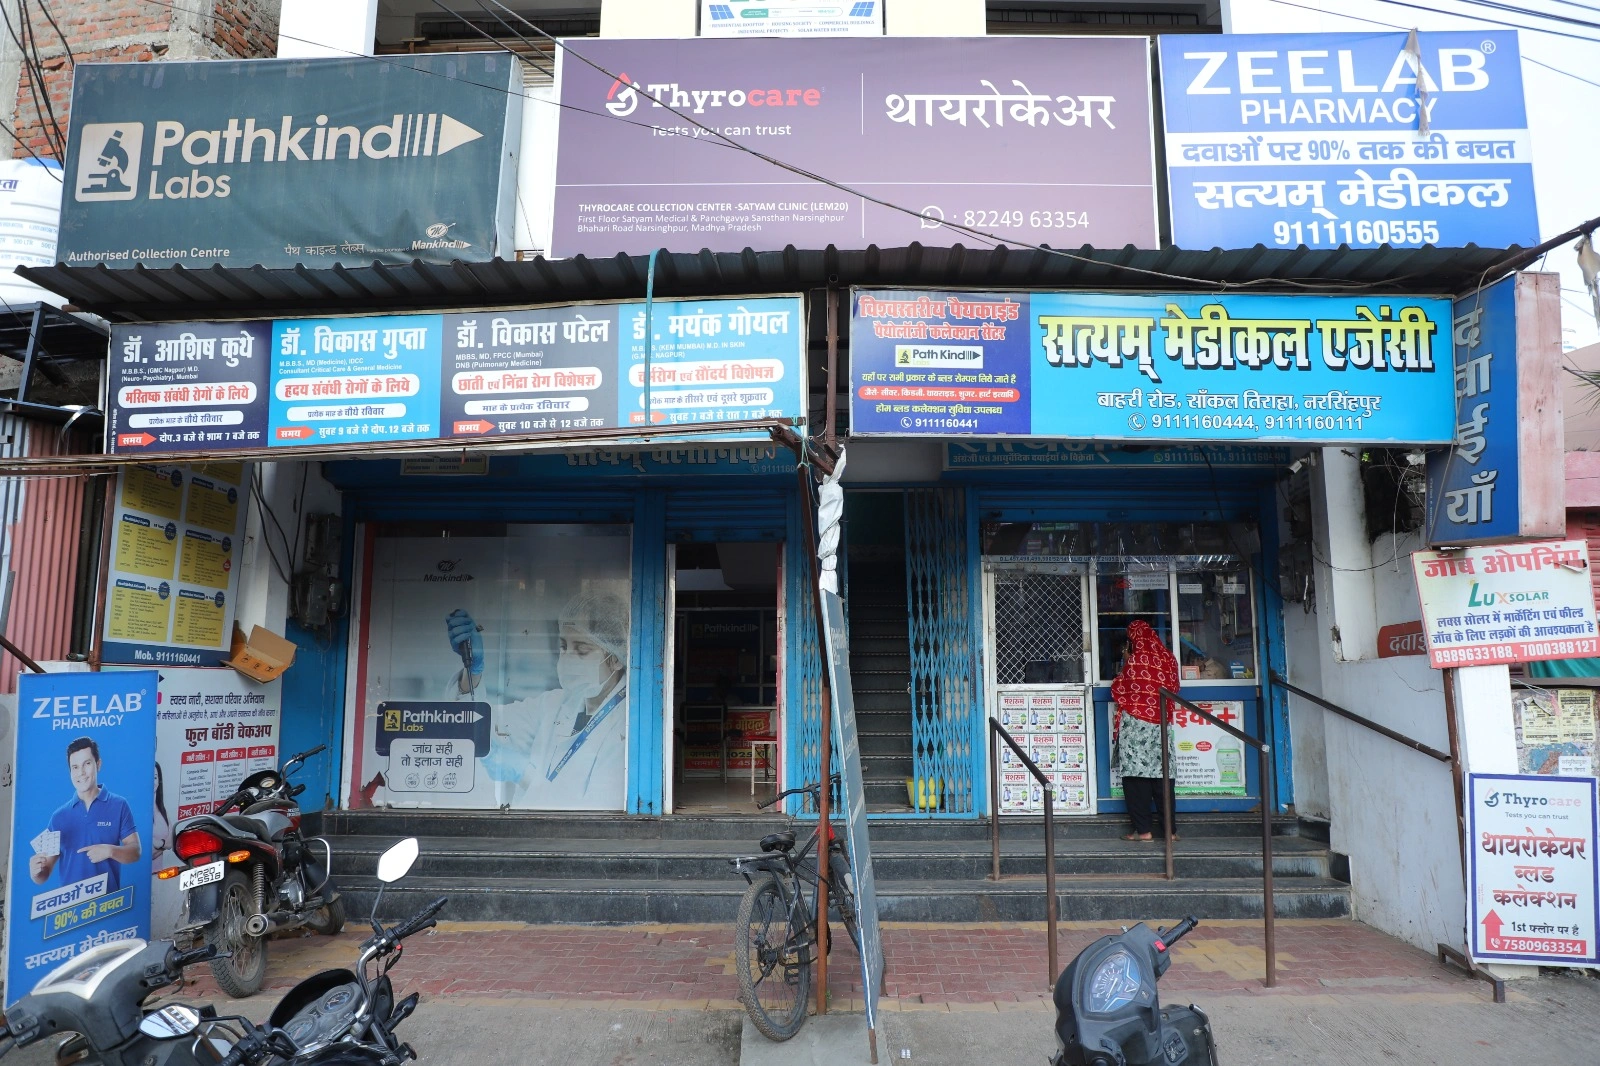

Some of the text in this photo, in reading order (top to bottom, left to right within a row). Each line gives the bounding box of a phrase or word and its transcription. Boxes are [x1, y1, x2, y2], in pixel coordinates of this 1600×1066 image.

[1183, 48, 1489, 95] ZEELAB
[648, 84, 821, 113] Thyrocare
[885, 79, 1116, 130] थायरोकेअर
[1240, 98, 1438, 124] PHARMACY
[152, 114, 404, 166] Pathkind
[652, 124, 792, 138] Tests you can trust
[1182, 134, 1515, 162] दवाओं पर 90% तक की बचत
[149, 170, 231, 200] Labs
[1193, 168, 1512, 219] सत्यम् मेडीकल
[579, 204, 634, 212] THYROCARE
[637, 204, 693, 212] COLLECTION
[695, 204, 732, 212] CENTER
[778, 202, 808, 211] CLINIC
[810, 202, 849, 212] (LEM20)
[578, 215, 596, 223] First
[598, 215, 620, 223] Floor
[622, 214, 652, 224] Satyam
[656, 214, 689, 222] Medical
[700, 214, 748, 224] Panchgavya
[751, 214, 790, 222] Sansthan
[792, 214, 844, 223] Narsinghpur
[612, 224, 633, 232] Road
[636, 224, 689, 233] Narsinghpur,
[691, 224, 725, 233] Madhya
[728, 224, 762, 232] Pradesh
[964, 210, 1089, 229] 82249 63354
[1274, 221, 1440, 245] 9111160555
[69, 246, 230, 261] Authorised Collection Centre
[285, 241, 300, 257] पैथ
[306, 243, 336, 256] काइन्ड
[341, 240, 365, 255] लैब्स
[411, 240, 456, 251] Mankind
[859, 296, 946, 319] विश्वस्तरीय
[668, 306, 790, 338] मयंक गोयल
[929, 323, 979, 340] कलेक्शन
[981, 323, 1006, 340] सेंटर
[457, 315, 610, 349] डॉ. विकास पटेल
[123, 336, 147, 363] डॉ.
[155, 333, 216, 361] आशिष
[281, 326, 427, 359] डॉ. विकास गुप्ता
[1039, 303, 1436, 384] सत्यम् मेडीकल एजेंसी
[472, 361, 508, 369] (Pulmonary
[458, 375, 484, 390] छाती
[488, 378, 499, 389] एवं
[532, 373, 551, 388] रोग
[554, 372, 595, 387] विशेषज्ञ
[1096, 389, 1381, 418] बाहरी रोड, साँकल तिराहा, नरसिंहपुर
[915, 418, 978, 428] 9111160441
[1151, 416, 1363, 432] 9111160444, 9111160111
[1421, 545, 1580, 577] जॉब ओपनिंग
[424, 574, 462, 582] Mankind
[1510, 591, 1549, 602] SOLAR
[1437, 607, 1584, 627] लक्स सोलर में मार्केटिंग एवं फील्ड
[1432, 621, 1594, 644] जॉब के लिए लड़कों की आवश्यकता है
[135, 650, 201, 663] Mob. 9111160441
[1435, 640, 1597, 663] 8989633188, 7000388127
[33, 693, 142, 718] ZEELAB
[52, 715, 123, 730] PHARMACY
[403, 710, 464, 723] Pathkind
[186, 722, 272, 746] फुल बॉडी चेकअप
[403, 724, 423, 732] Labs
[412, 742, 453, 754] जांच सही
[401, 755, 463, 768] तो इलाज सही
[1503, 793, 1581, 807] Thyrocare
[1482, 827, 1586, 859] थायरोकेयर
[190, 867, 215, 879] MP20
[1514, 865, 1554, 883] ब्लड
[183, 880, 194, 888] KK
[35, 881, 103, 912] दवाओं पर
[1493, 884, 1577, 909] कलेक्शन
[54, 896, 124, 930] 90% की बचत
[1512, 922, 1579, 935] 1st फ्लोर पर है
[1503, 939, 1582, 953] 7580963354
